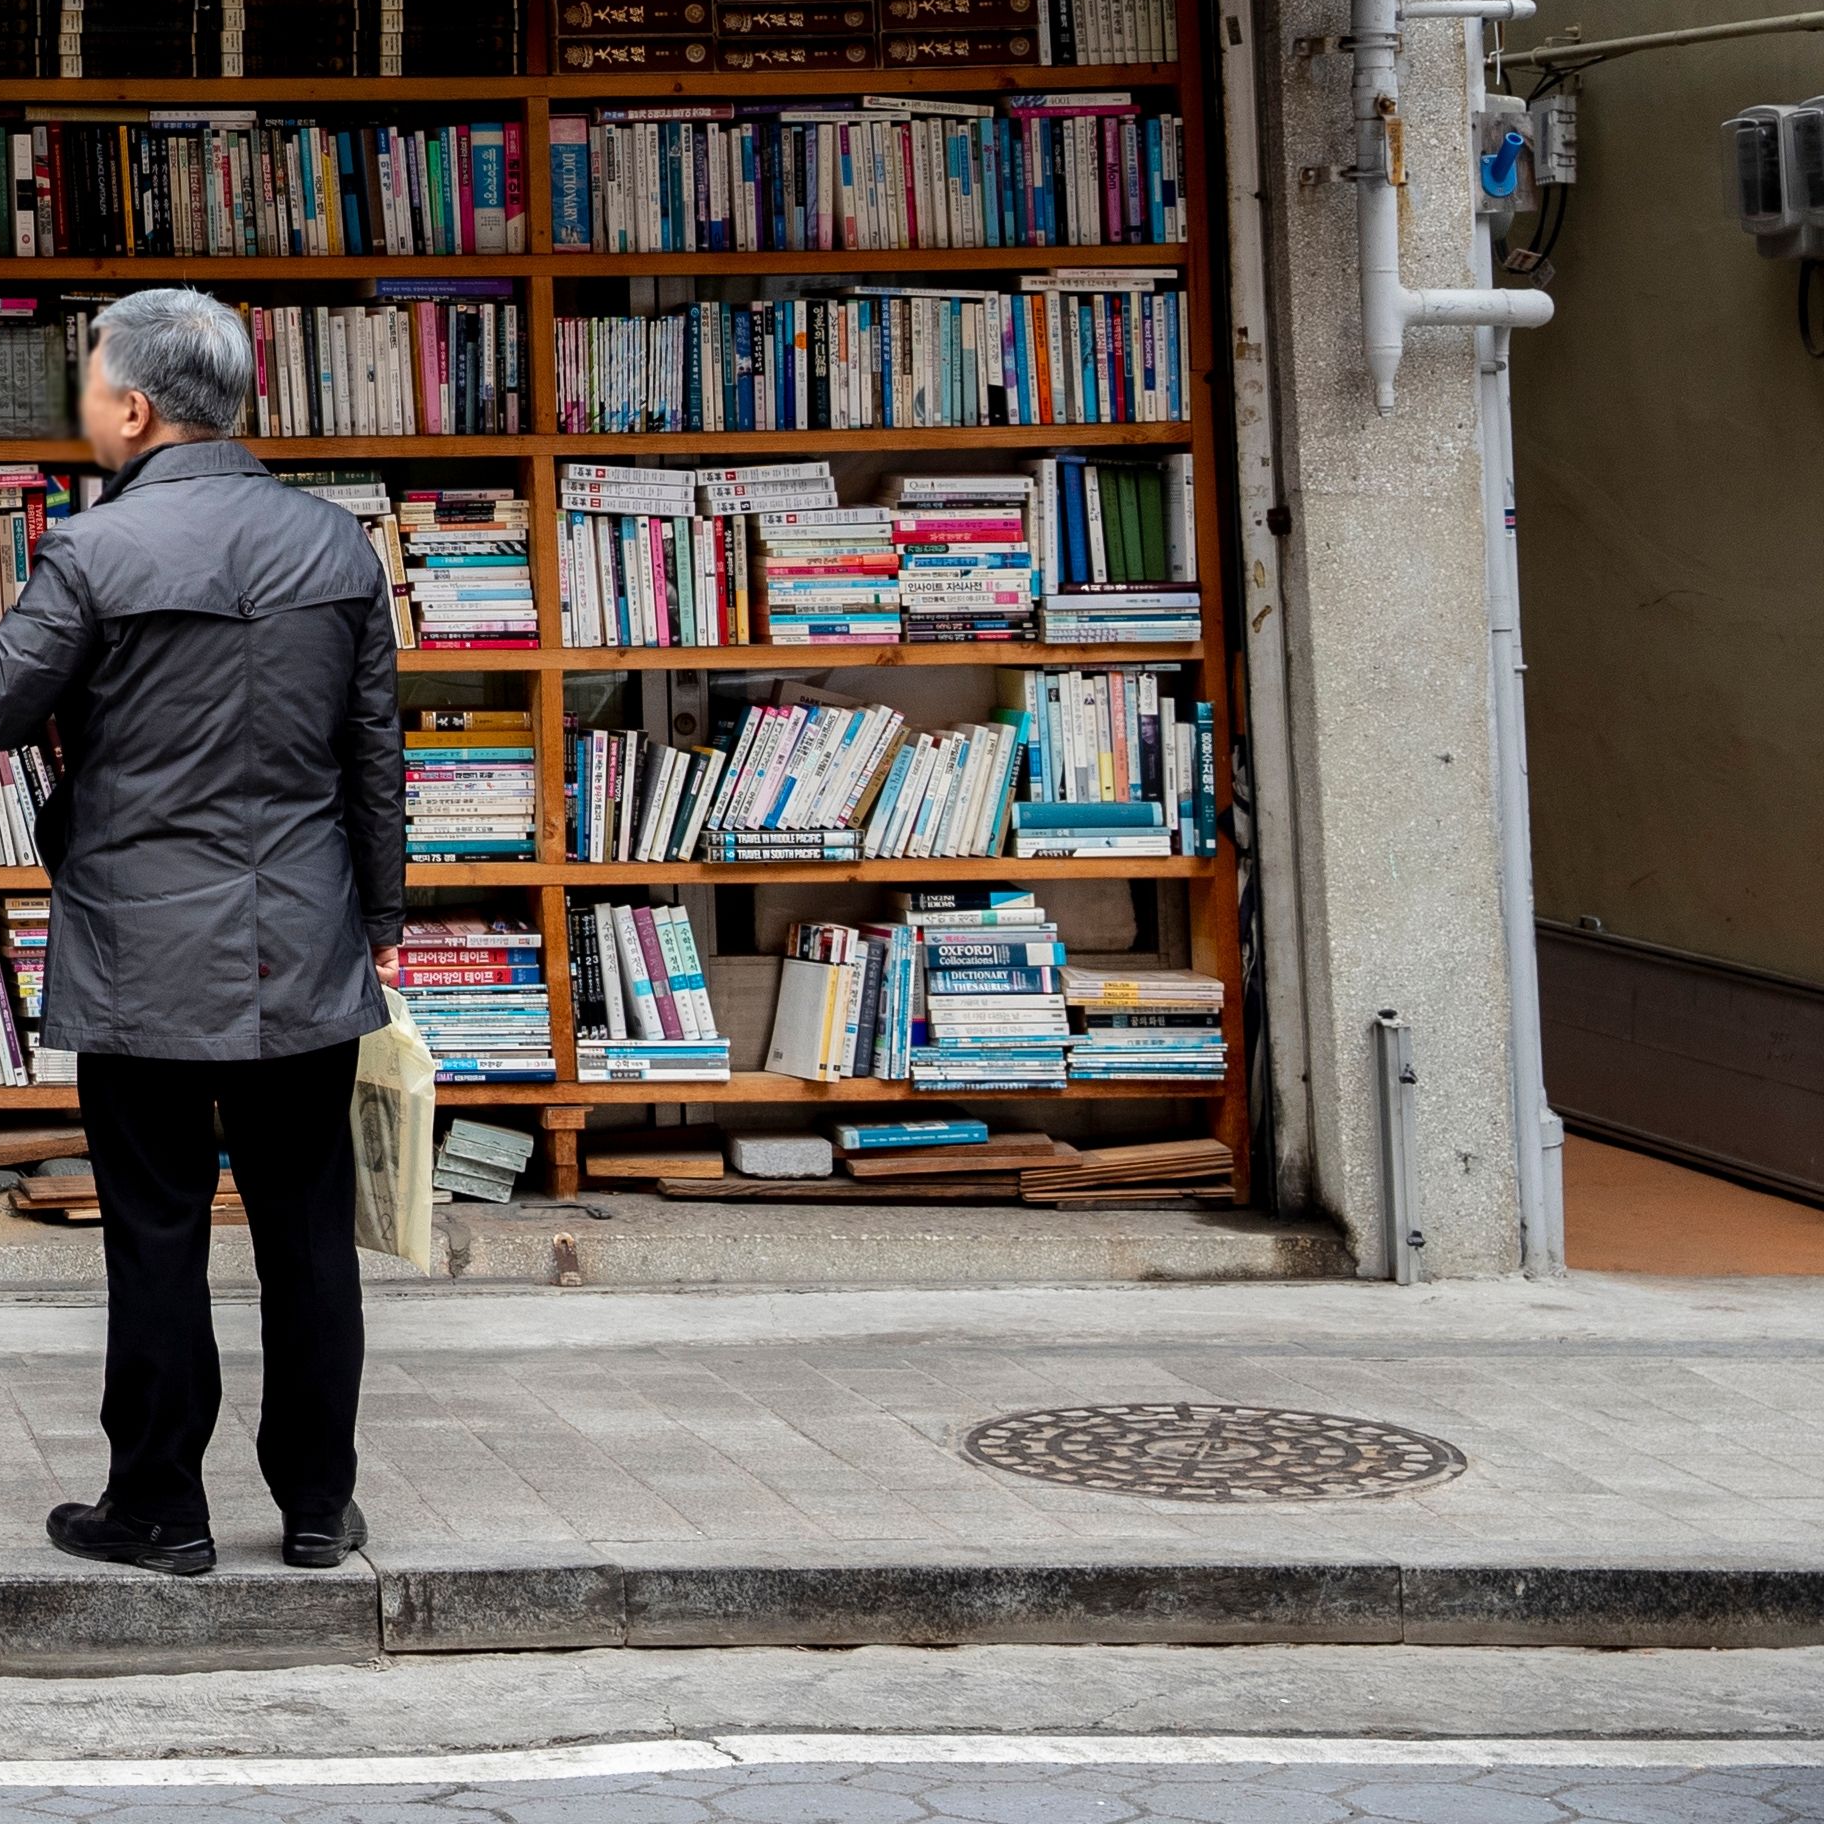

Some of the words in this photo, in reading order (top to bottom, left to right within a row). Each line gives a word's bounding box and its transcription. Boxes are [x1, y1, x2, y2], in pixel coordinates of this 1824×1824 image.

[561, 152, 577, 223] DICTIONARY
[27, 505, 36, 541] BRITAIN
[907, 581, 944, 594] 인사이트
[946, 581, 983, 594] 지식사전
[736, 833, 759, 843] TRAVEL
[761, 833, 768, 843] IN
[770, 833, 793, 843] MIDDLE
[795, 833, 822, 843] PACIFIC
[736, 849, 759, 859] TRAVEL
[761, 849, 768, 859] IN
[770, 849, 792, 859] SOUTH
[794, 849, 821, 859] PACIFIC
[939, 945, 993, 957] OXFORD
[939, 956, 994, 966] Collocations
[951, 971, 1008, 980] DICTIONARY
[952, 981, 1011, 992] THESAURUS
